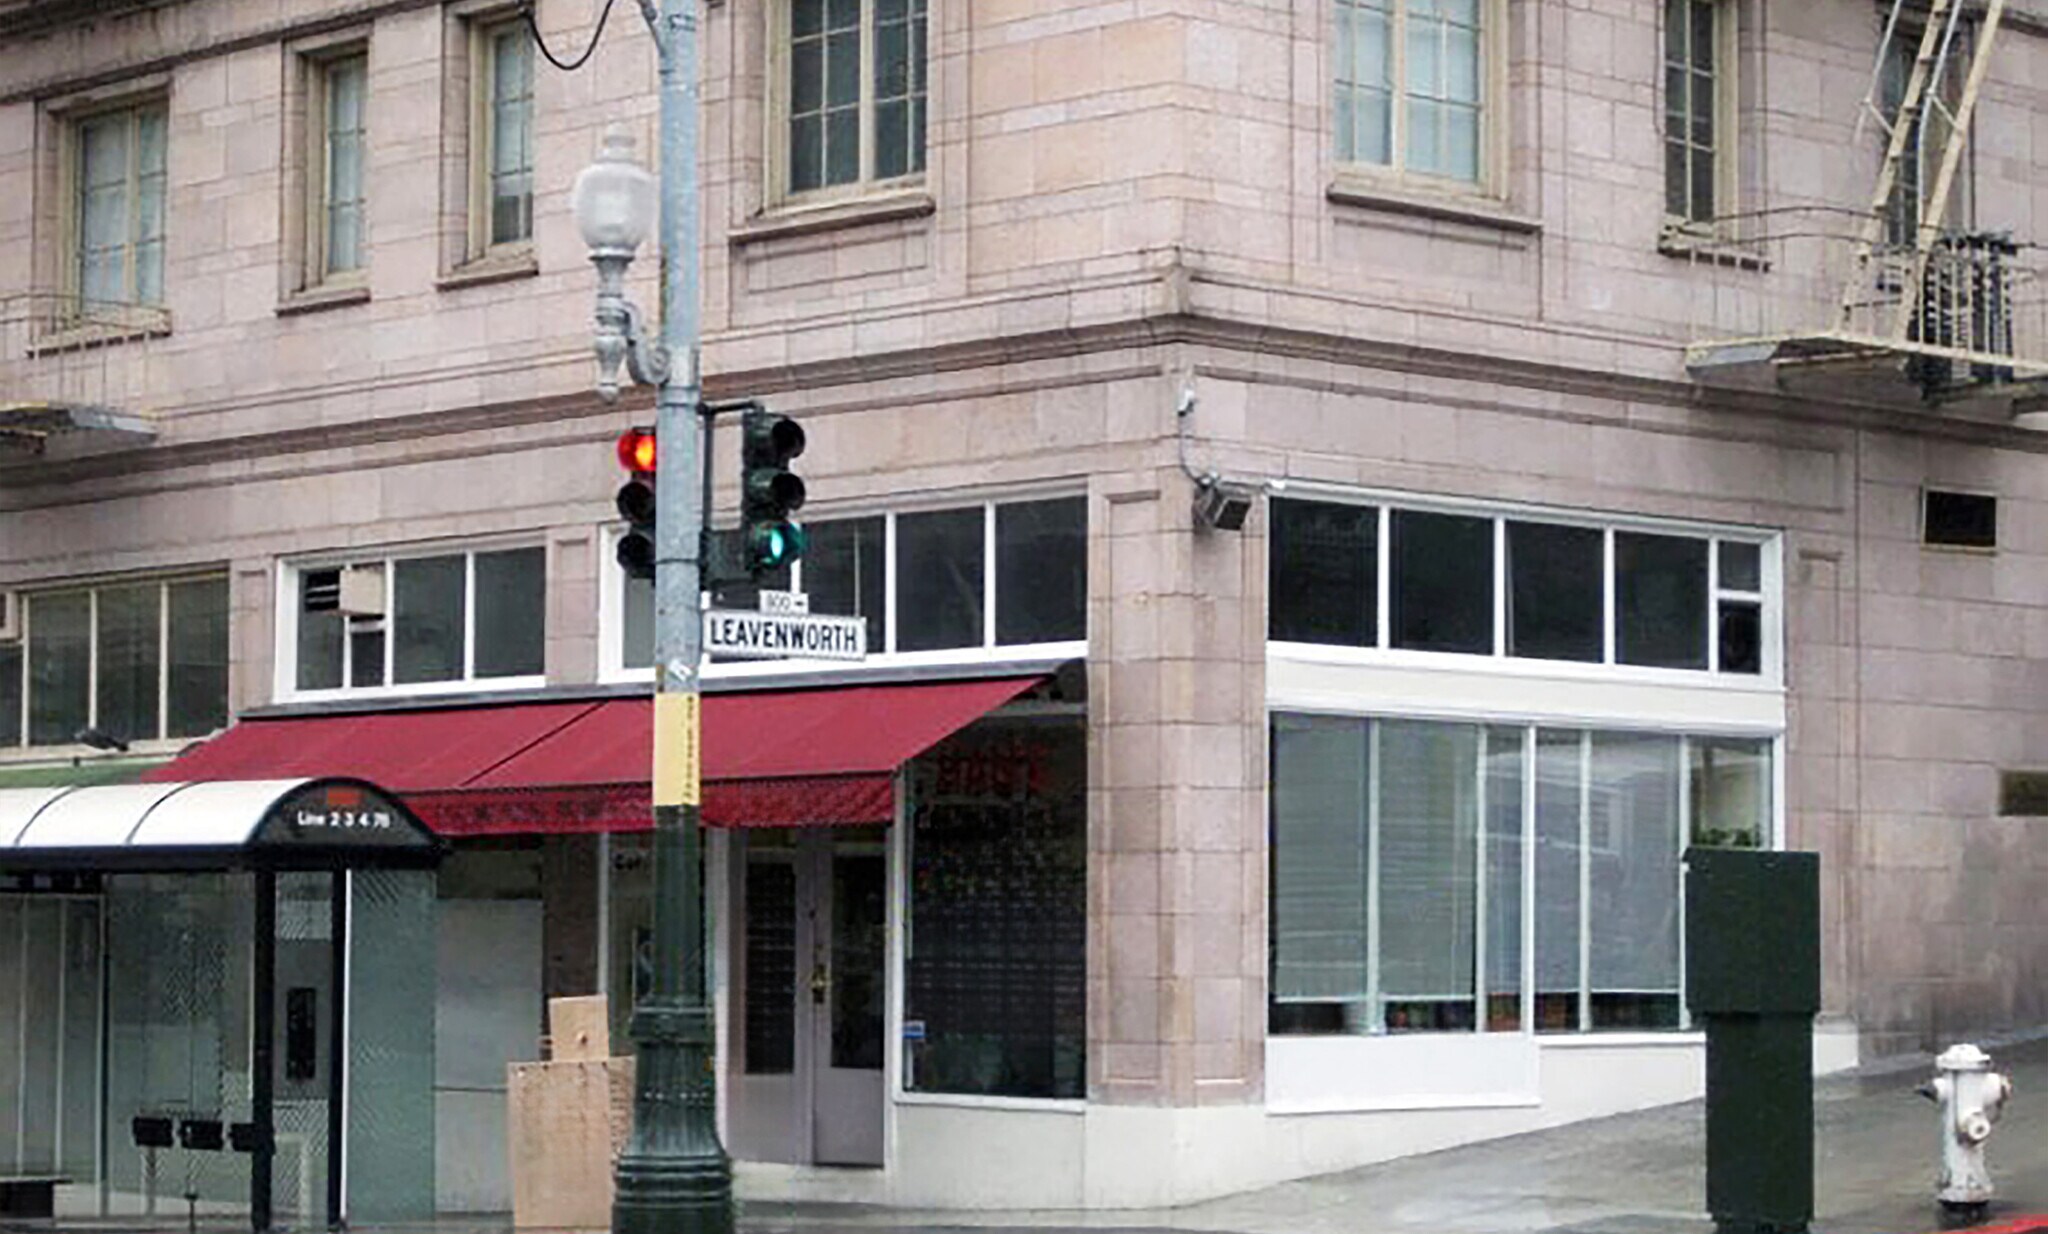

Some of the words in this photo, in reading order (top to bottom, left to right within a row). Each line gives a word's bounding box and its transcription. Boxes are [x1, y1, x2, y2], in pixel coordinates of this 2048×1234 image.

[710, 618, 857, 652] LEAVENWORTH
[330, 812, 341, 827] 2
[344, 812, 355, 827] 3
[359, 812, 369, 827] 4
